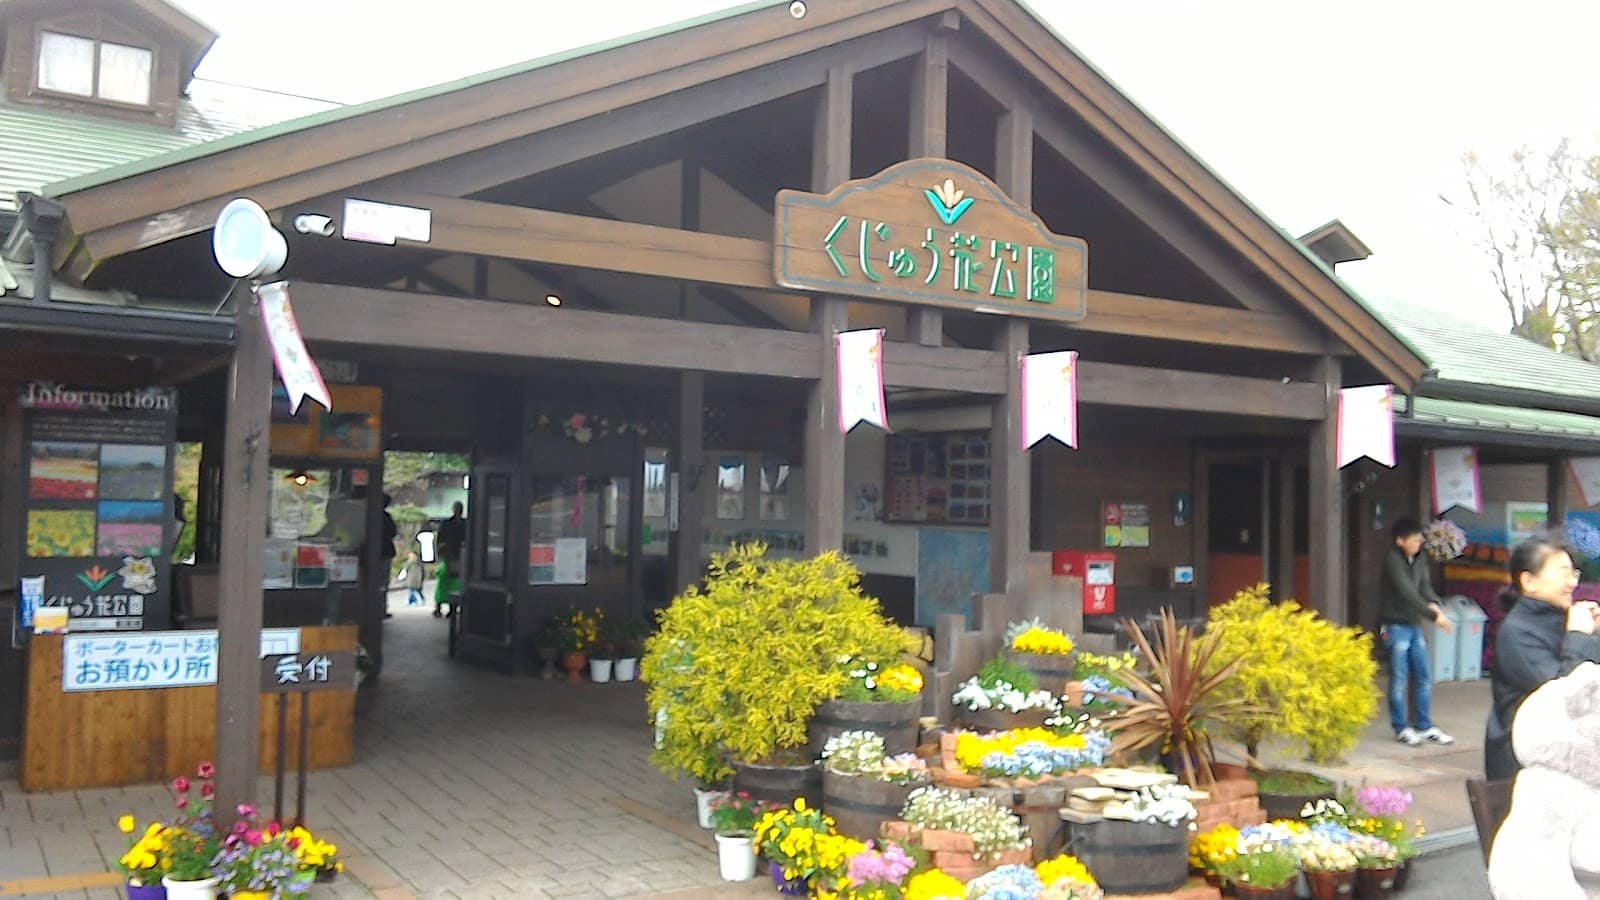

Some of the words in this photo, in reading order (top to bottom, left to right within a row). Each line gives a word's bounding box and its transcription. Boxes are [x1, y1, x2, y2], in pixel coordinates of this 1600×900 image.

[824, 215, 1056, 304] くじゅう花公園
[24, 383, 169, 410] Information
[75, 655, 211, 685] お預かり所
[273, 654, 333, 684] 受付
